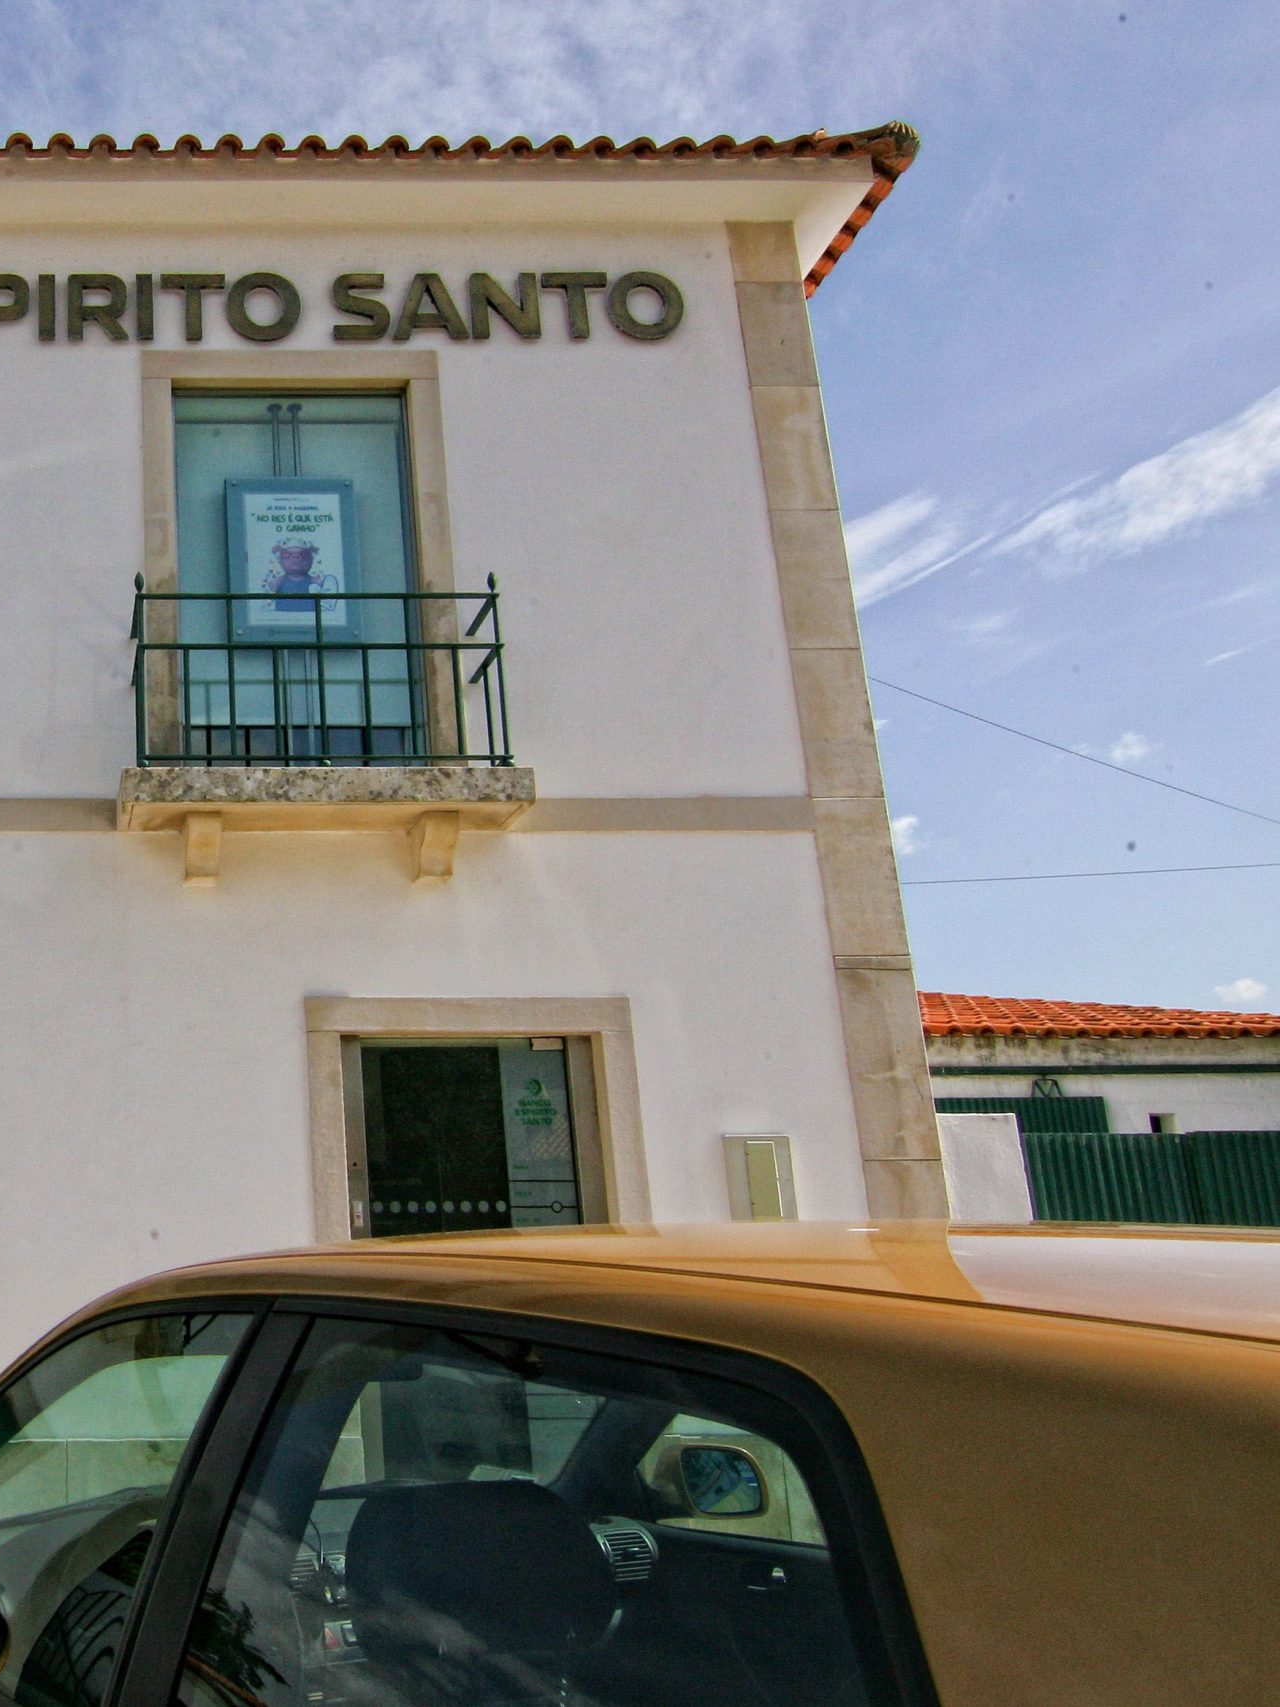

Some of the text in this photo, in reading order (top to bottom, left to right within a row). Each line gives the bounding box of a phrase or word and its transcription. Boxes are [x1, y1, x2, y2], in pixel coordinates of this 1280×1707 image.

[332, 271, 684, 341] SANTO
[518, 1099, 551, 1107] BANCO
[520, 1118, 553, 1126] SANTO
